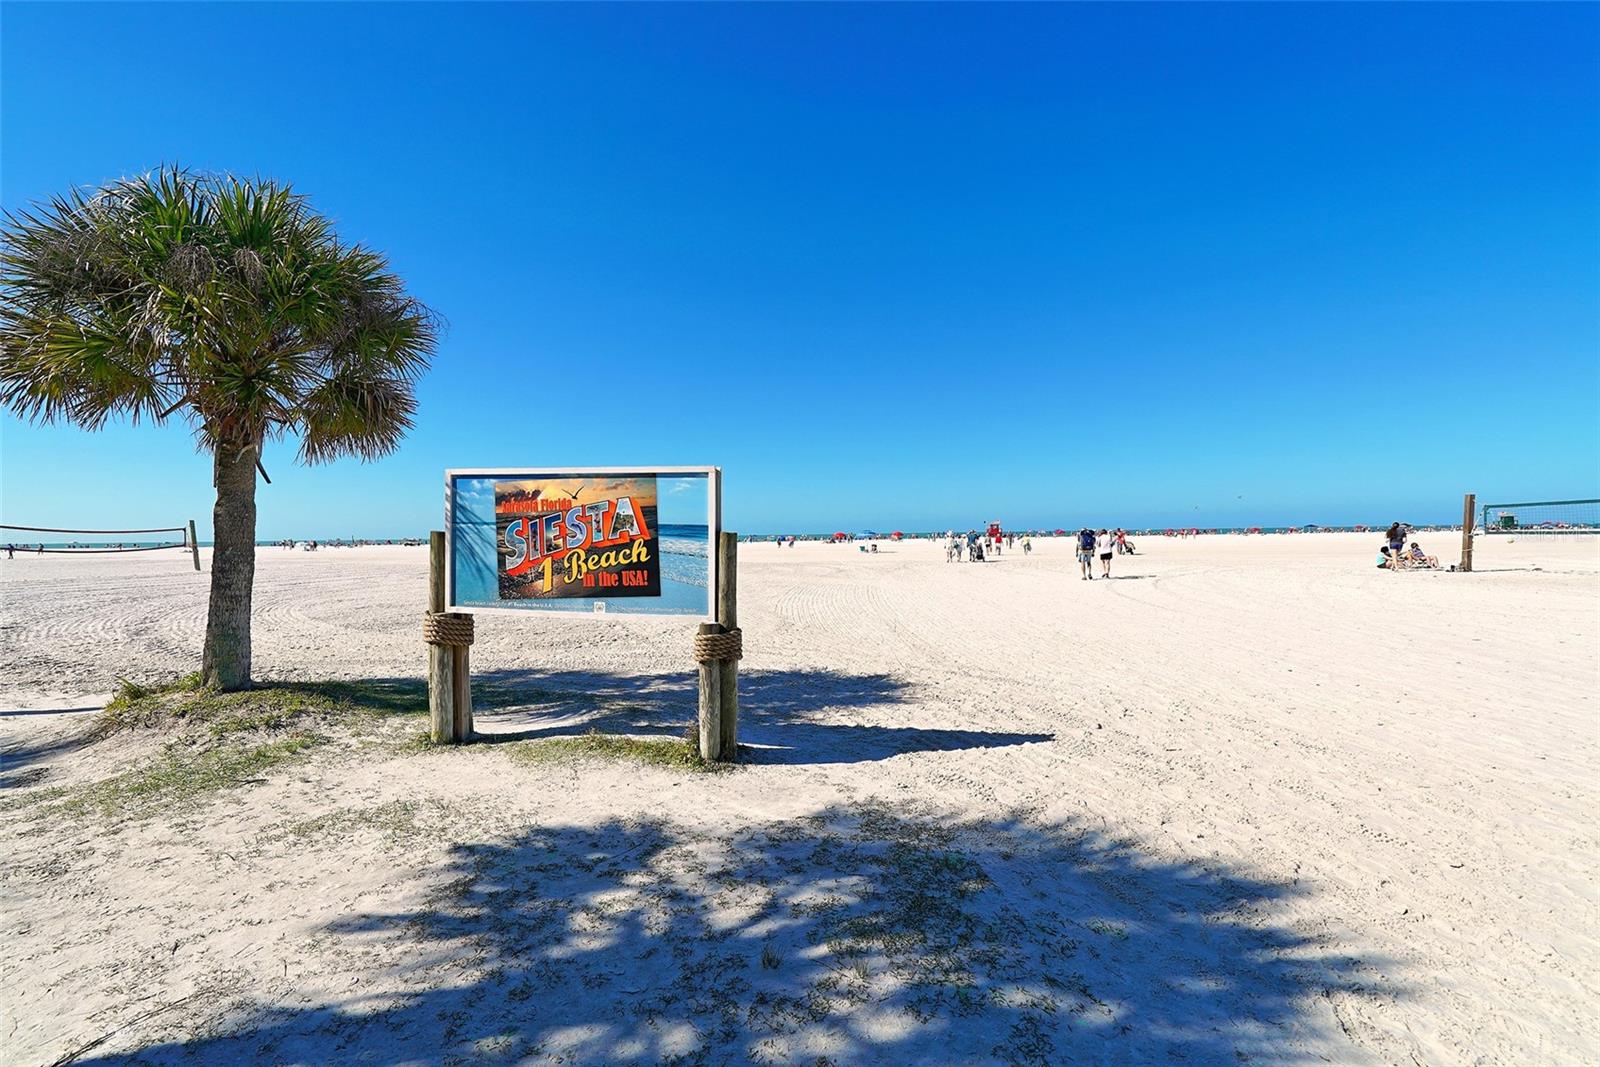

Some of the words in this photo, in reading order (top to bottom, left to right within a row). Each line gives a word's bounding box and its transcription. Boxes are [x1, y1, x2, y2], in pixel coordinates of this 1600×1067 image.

[541, 497, 571, 510] Florida
[504, 496, 652, 576] SIESTA
[563, 538, 651, 584] Beach
[583, 573, 595, 587] in
[598, 572, 619, 587] the
[621, 570, 648, 587] USA!
